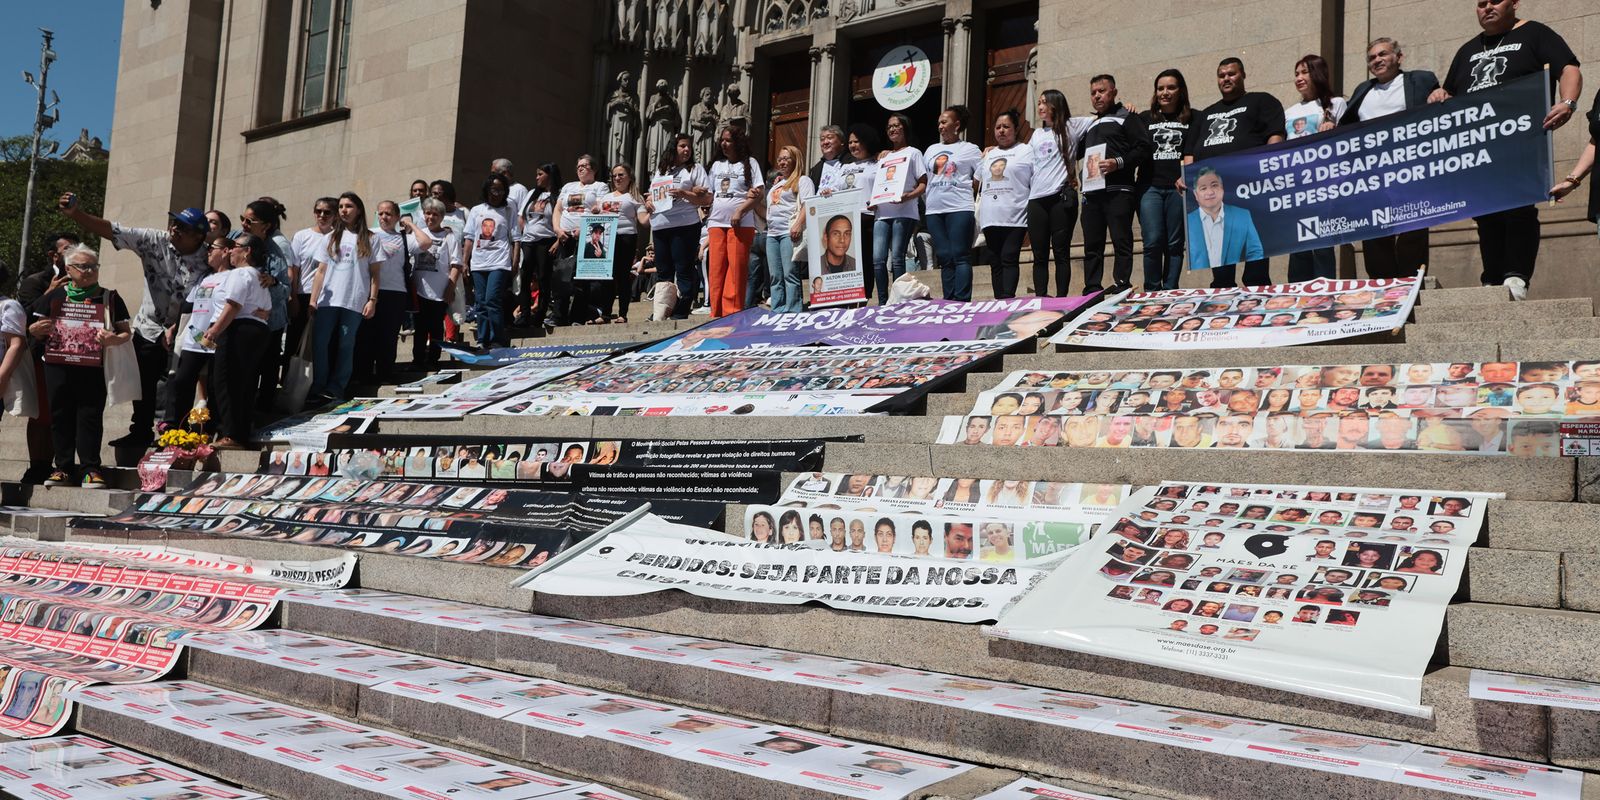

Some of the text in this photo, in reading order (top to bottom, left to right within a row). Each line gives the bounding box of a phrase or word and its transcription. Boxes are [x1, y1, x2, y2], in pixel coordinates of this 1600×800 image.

[1259, 102, 1496, 174] ESTADO DE SP REGISTRA
[1236, 114, 1532, 199] QUASE 2 DESAPARECIMENTOS
[1269, 148, 1493, 212] DE PESSOAS POR HORA
[1389, 199, 1431, 215] Instituto
[1390, 208, 1419, 222] Mércia
[1419, 200, 1467, 216] Nakashima
[1319, 216, 1347, 228] MÁRCIO
[1319, 217, 1370, 235] NAKASHIMA
[1129, 276, 1418, 300] DESAPARECIDOS
[1173, 330, 1200, 343] 181
[661, 347, 794, 363] CONTINUAM
[794, 340, 1003, 358] DESAPARECIDOS
[721, 450, 742, 459] violação
[743, 450, 750, 458] de
[750, 450, 770, 458] direitos
[666, 471, 700, 479] reconhecido;
[723, 486, 760, 494] reconhecida;
[626, 551, 1018, 586] PERDIDOS: SEJA PARTE DA NOSSA
[1156, 637, 1236, 654] www.maesdase.org.br
